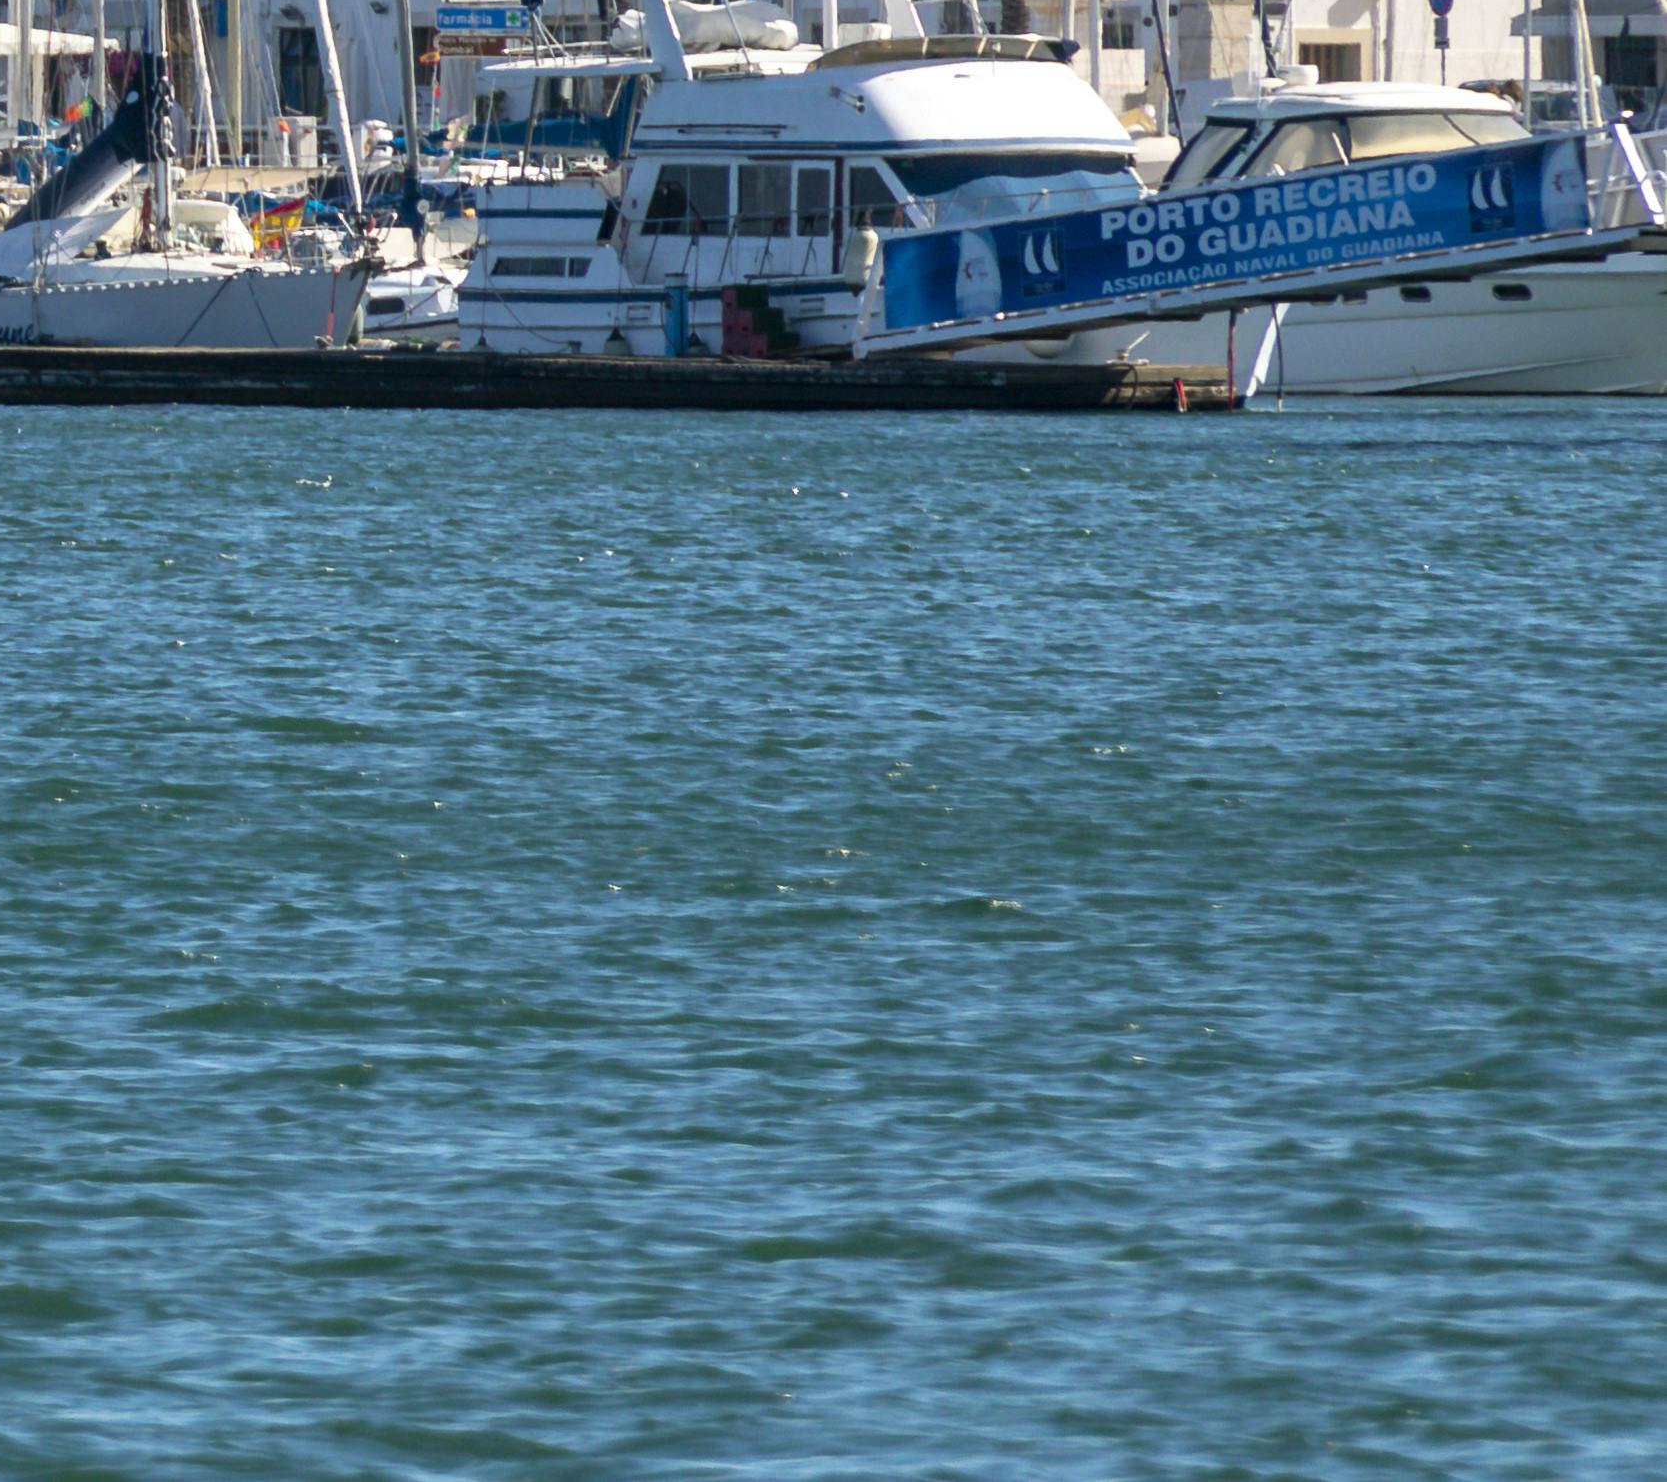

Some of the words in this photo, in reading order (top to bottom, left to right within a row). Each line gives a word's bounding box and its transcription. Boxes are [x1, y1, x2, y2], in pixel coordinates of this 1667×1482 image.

[1100, 194, 1240, 240] PORTO
[1254, 163, 1437, 217] RECREIO
[1126, 234, 1186, 269] DO
[1198, 200, 1416, 257] GUADIANA
[1101, 261, 1228, 295] ASSOCIAÇÃO
[1234, 252, 1298, 275] NAVAL
[1306, 246, 1333, 262] DO
[1340, 230, 1445, 259] GUADIANA
